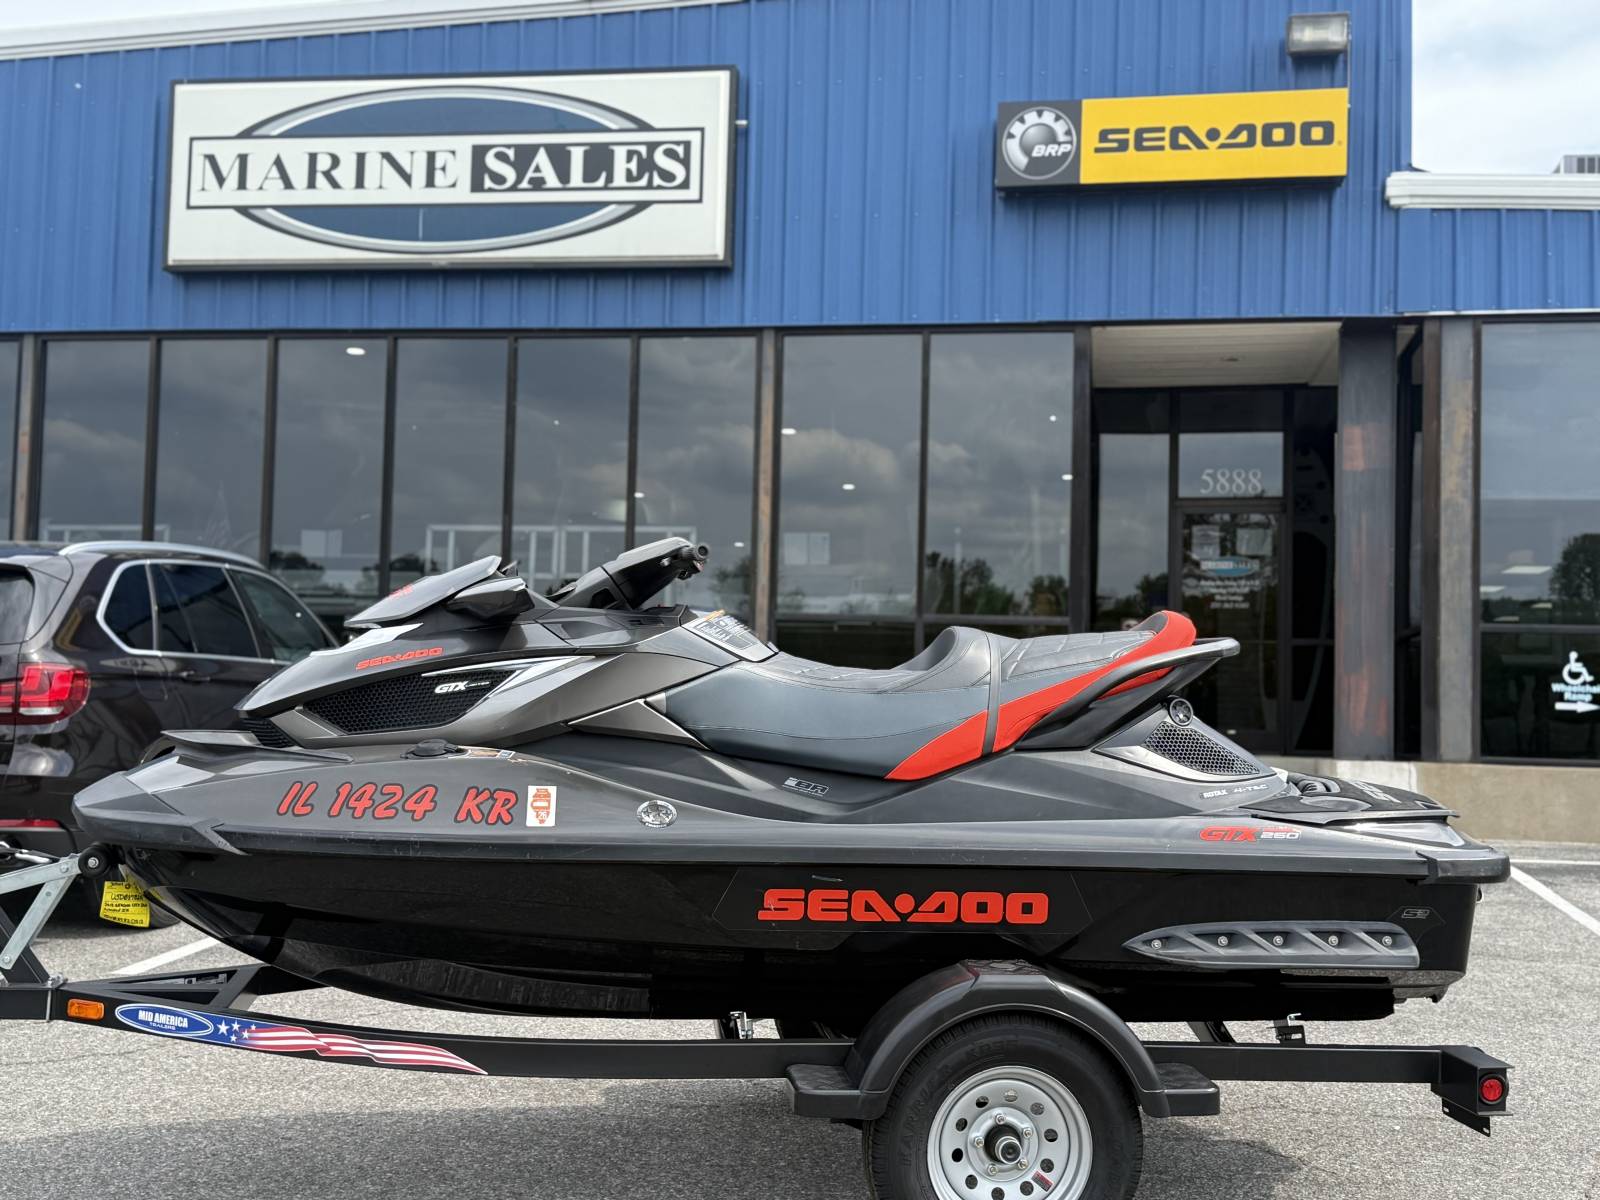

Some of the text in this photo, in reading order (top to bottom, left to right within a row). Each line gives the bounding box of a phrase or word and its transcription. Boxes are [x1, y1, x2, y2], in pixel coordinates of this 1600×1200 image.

[1031, 143, 1072, 158] BRP
[197, 142, 690, 193] MARINE SALES
[1200, 468, 1263, 494] 5888
[434, 680, 469, 694] GTX
[276, 780, 319, 817] IL
[327, 782, 438, 822] 1424
[454, 785, 519, 826] KR
[1202, 789, 1229, 799] ROTAX
[1199, 825, 1258, 843] GTX
[138, 1009, 189, 1029] MID AMERICA
